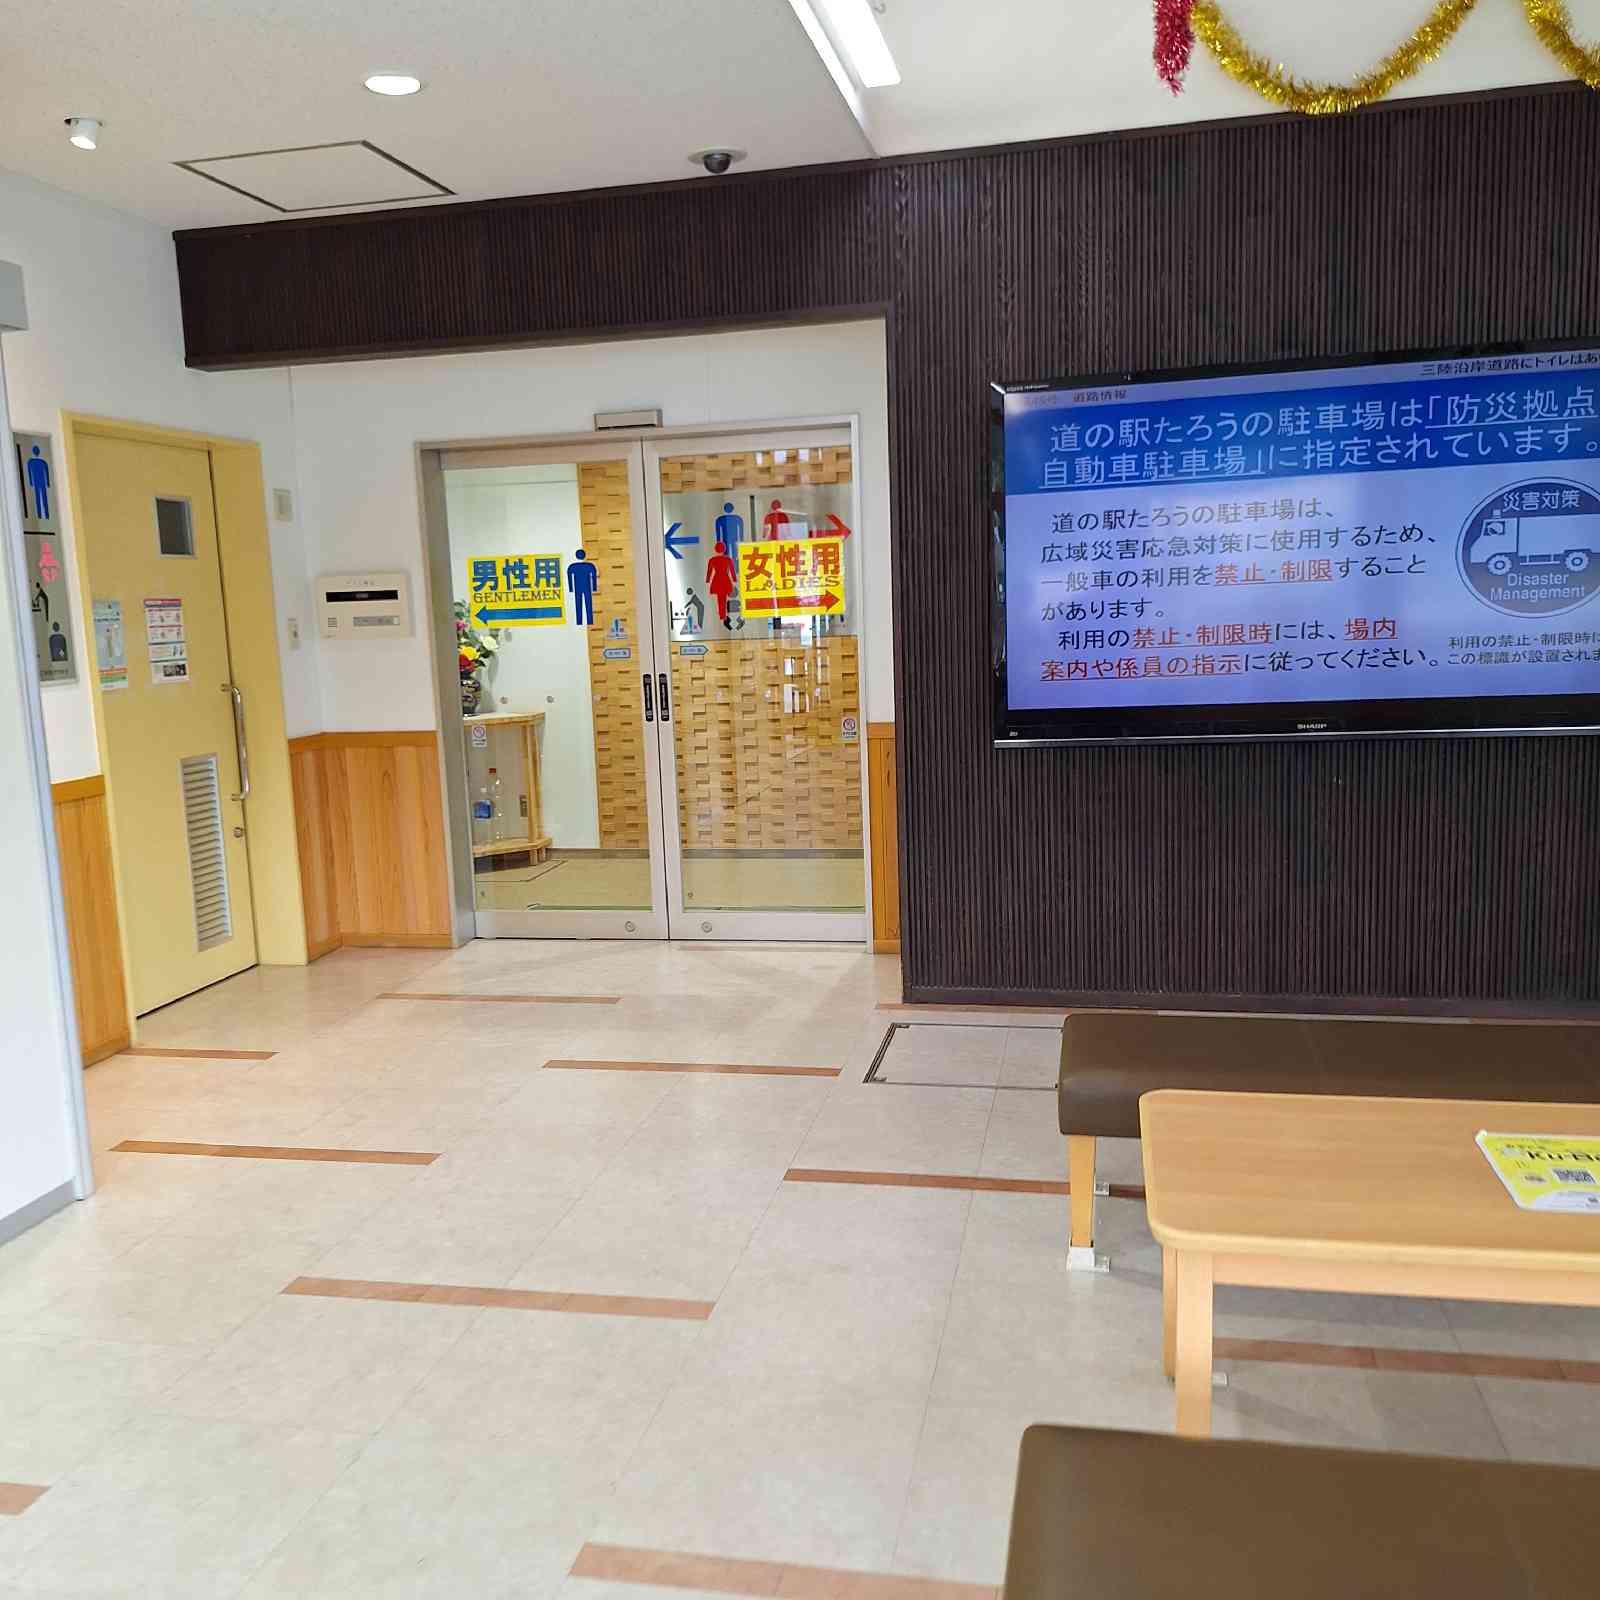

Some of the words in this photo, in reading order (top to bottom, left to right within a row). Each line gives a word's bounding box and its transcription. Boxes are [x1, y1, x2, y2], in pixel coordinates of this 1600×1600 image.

[1502, 489, 1580, 512] 災害対策
[1052, 497, 1334, 533] 道の駅たろうの駐車場は、
[1041, 523, 1437, 563] 広域災害応急対策に使用するため、
[742, 542, 840, 579] 女性用
[472, 557, 561, 591] 男性用
[745, 575, 840, 592] LADIES
[1507, 573, 1570, 586] Disaster
[473, 589, 561, 603] GENTLEMEN
[1490, 586, 1585, 602] Management
[1041, 597, 1164, 622] があります。
[1041, 649, 1439, 680] 案内や係員の指示に従ってください。
